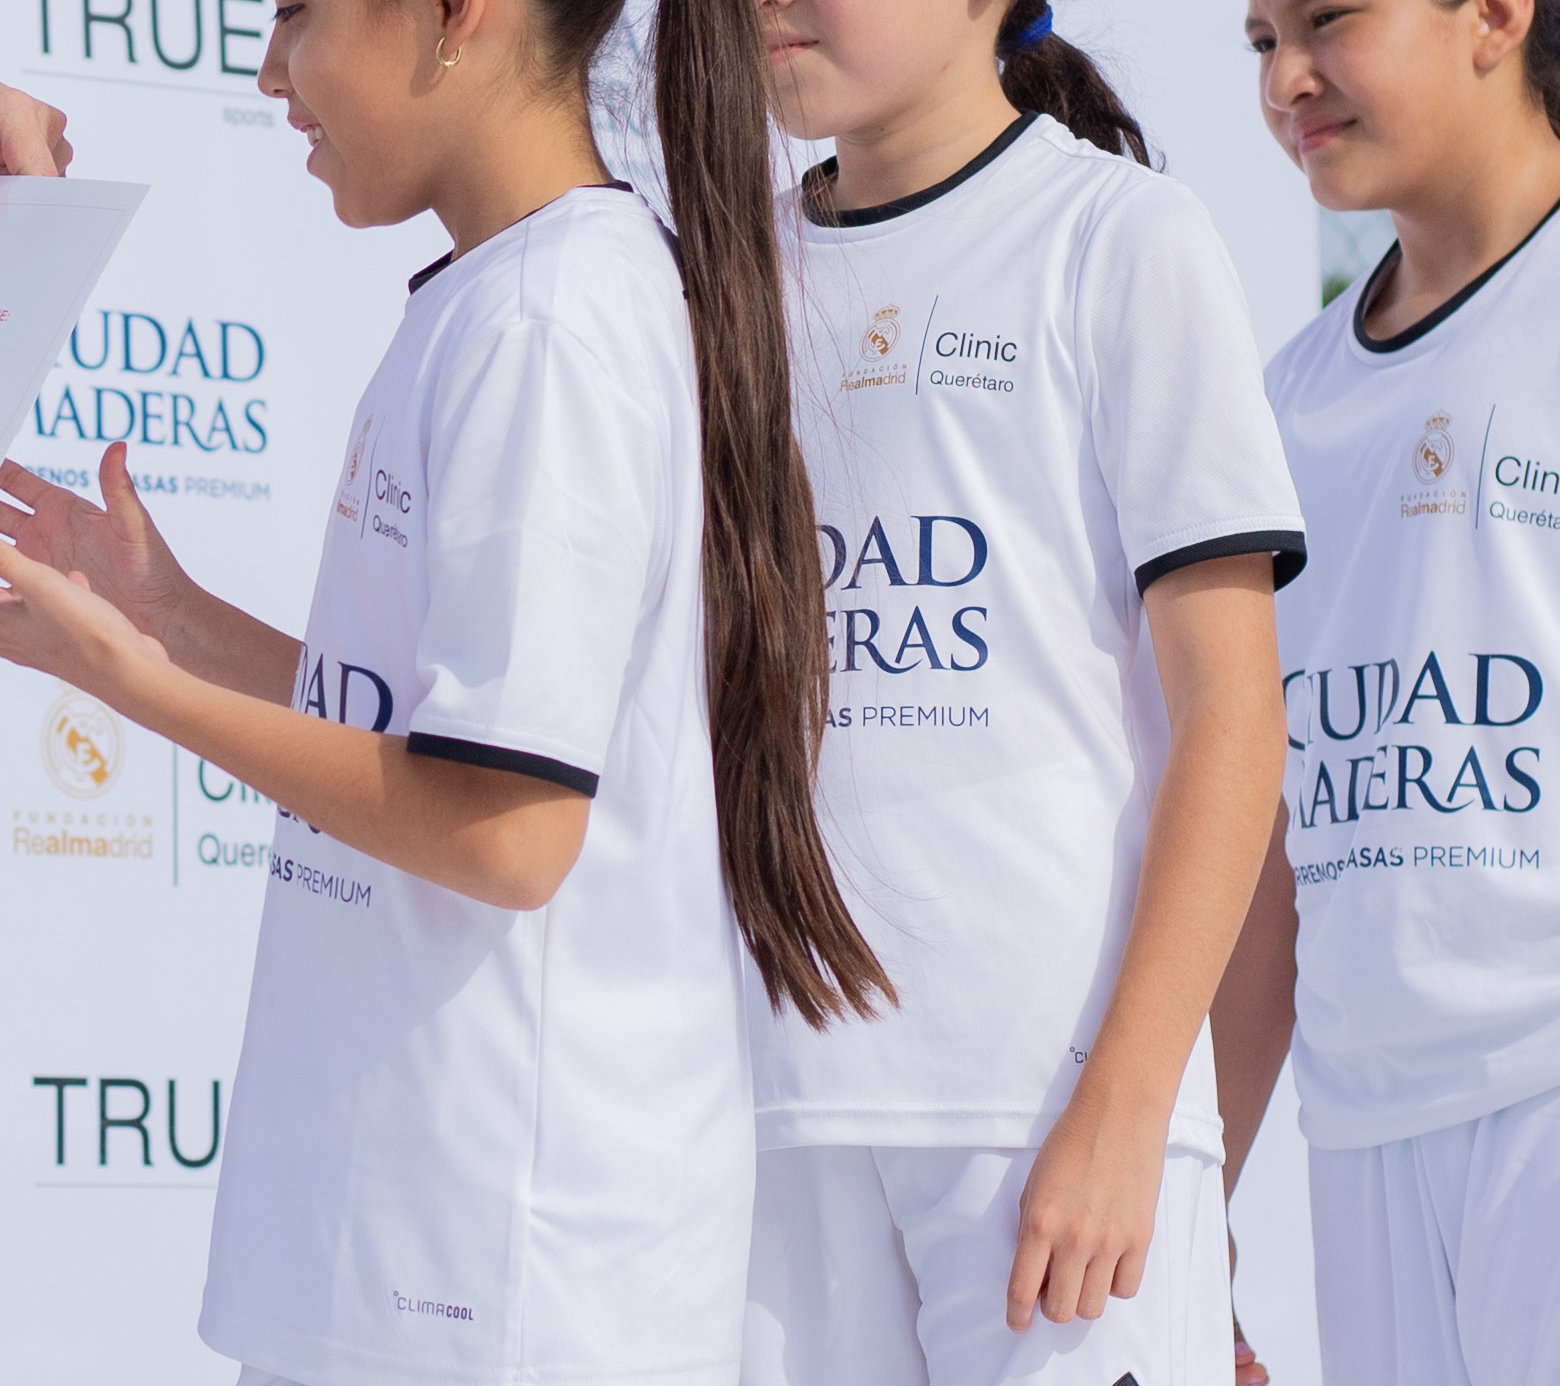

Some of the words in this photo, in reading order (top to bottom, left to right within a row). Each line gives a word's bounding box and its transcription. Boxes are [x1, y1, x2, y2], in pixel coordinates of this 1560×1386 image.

[223, 106, 275, 128] sports
[68, 310, 266, 382] UDAD
[935, 331, 1018, 362] Clinic
[930, 370, 1014, 393] Querétaro
[133, 473, 178, 494] ASAS
[185, 476, 271, 501] PREMIUM
[816, 515, 988, 590] DAD
[863, 705, 989, 728] PREMIUM
[13, 828, 152, 859] Realmadrid
[1346, 846, 1404, 869] ASAS
[1413, 846, 1540, 869] PREMIUM
[298, 864, 371, 907] PREMIUM
[34, 1077, 225, 1168] TRU
[395, 1293, 475, 1321] CLIMACOOL
